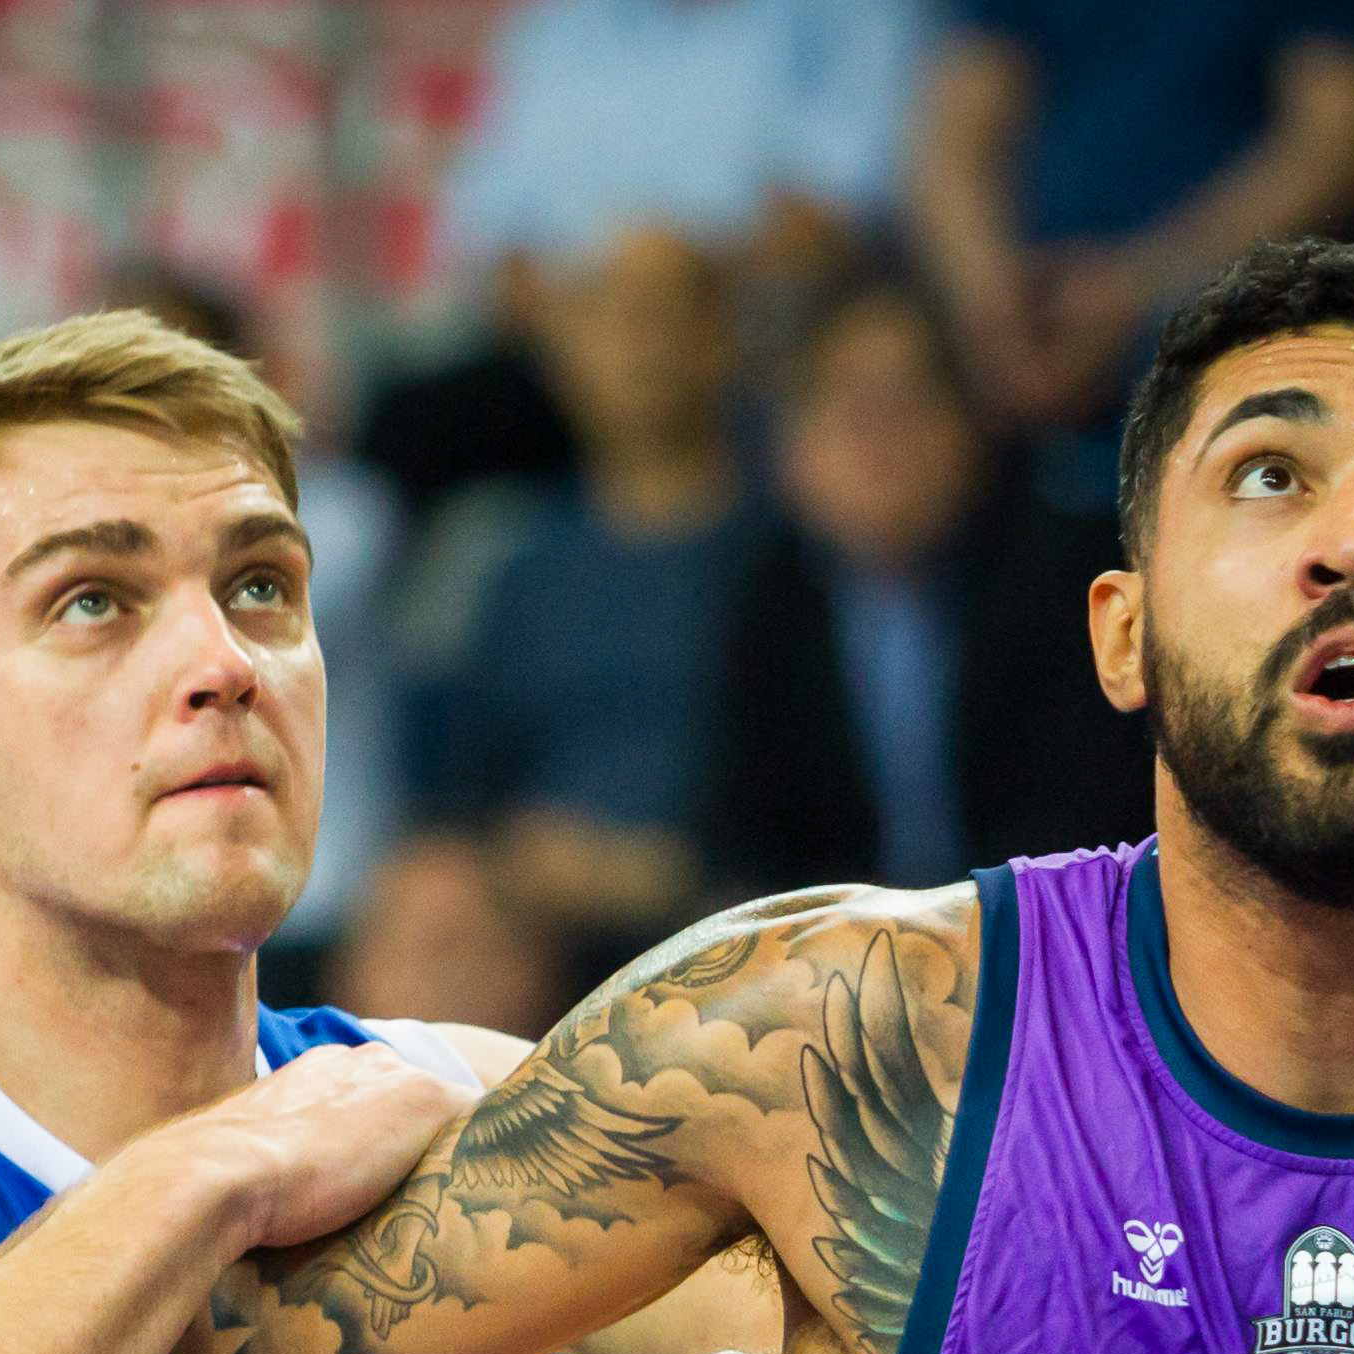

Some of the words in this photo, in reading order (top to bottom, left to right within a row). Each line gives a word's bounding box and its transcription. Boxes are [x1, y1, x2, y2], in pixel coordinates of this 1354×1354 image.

[1112, 1270, 1190, 1307] hummel
[1294, 1307, 1316, 1317] SAN
[1319, 1308, 1353, 1319] PABLO
